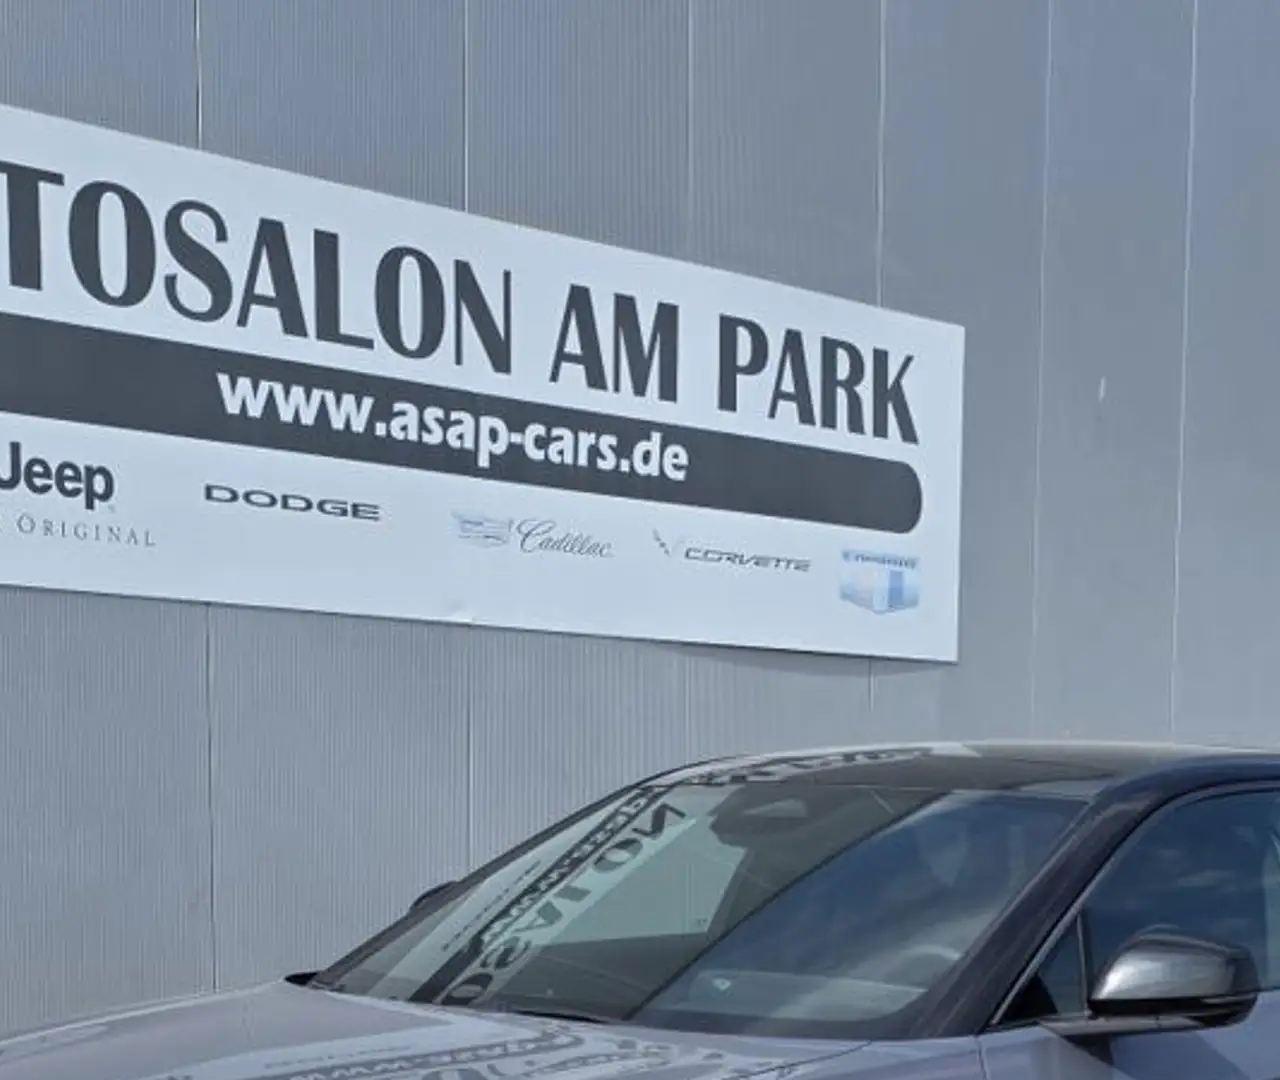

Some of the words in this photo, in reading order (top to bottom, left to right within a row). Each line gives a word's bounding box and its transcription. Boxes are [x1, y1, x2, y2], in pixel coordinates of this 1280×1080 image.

[549, 283, 680, 404] AM
[718, 312, 920, 445] PARK
[217, 372, 690, 481] www.asap-cars.de
[204, 484, 381, 521] DODGE
[16, 513, 157, 547] ORIGINAL
[516, 519, 615, 558] Cadillac
[684, 547, 811, 573] CORVETTE
